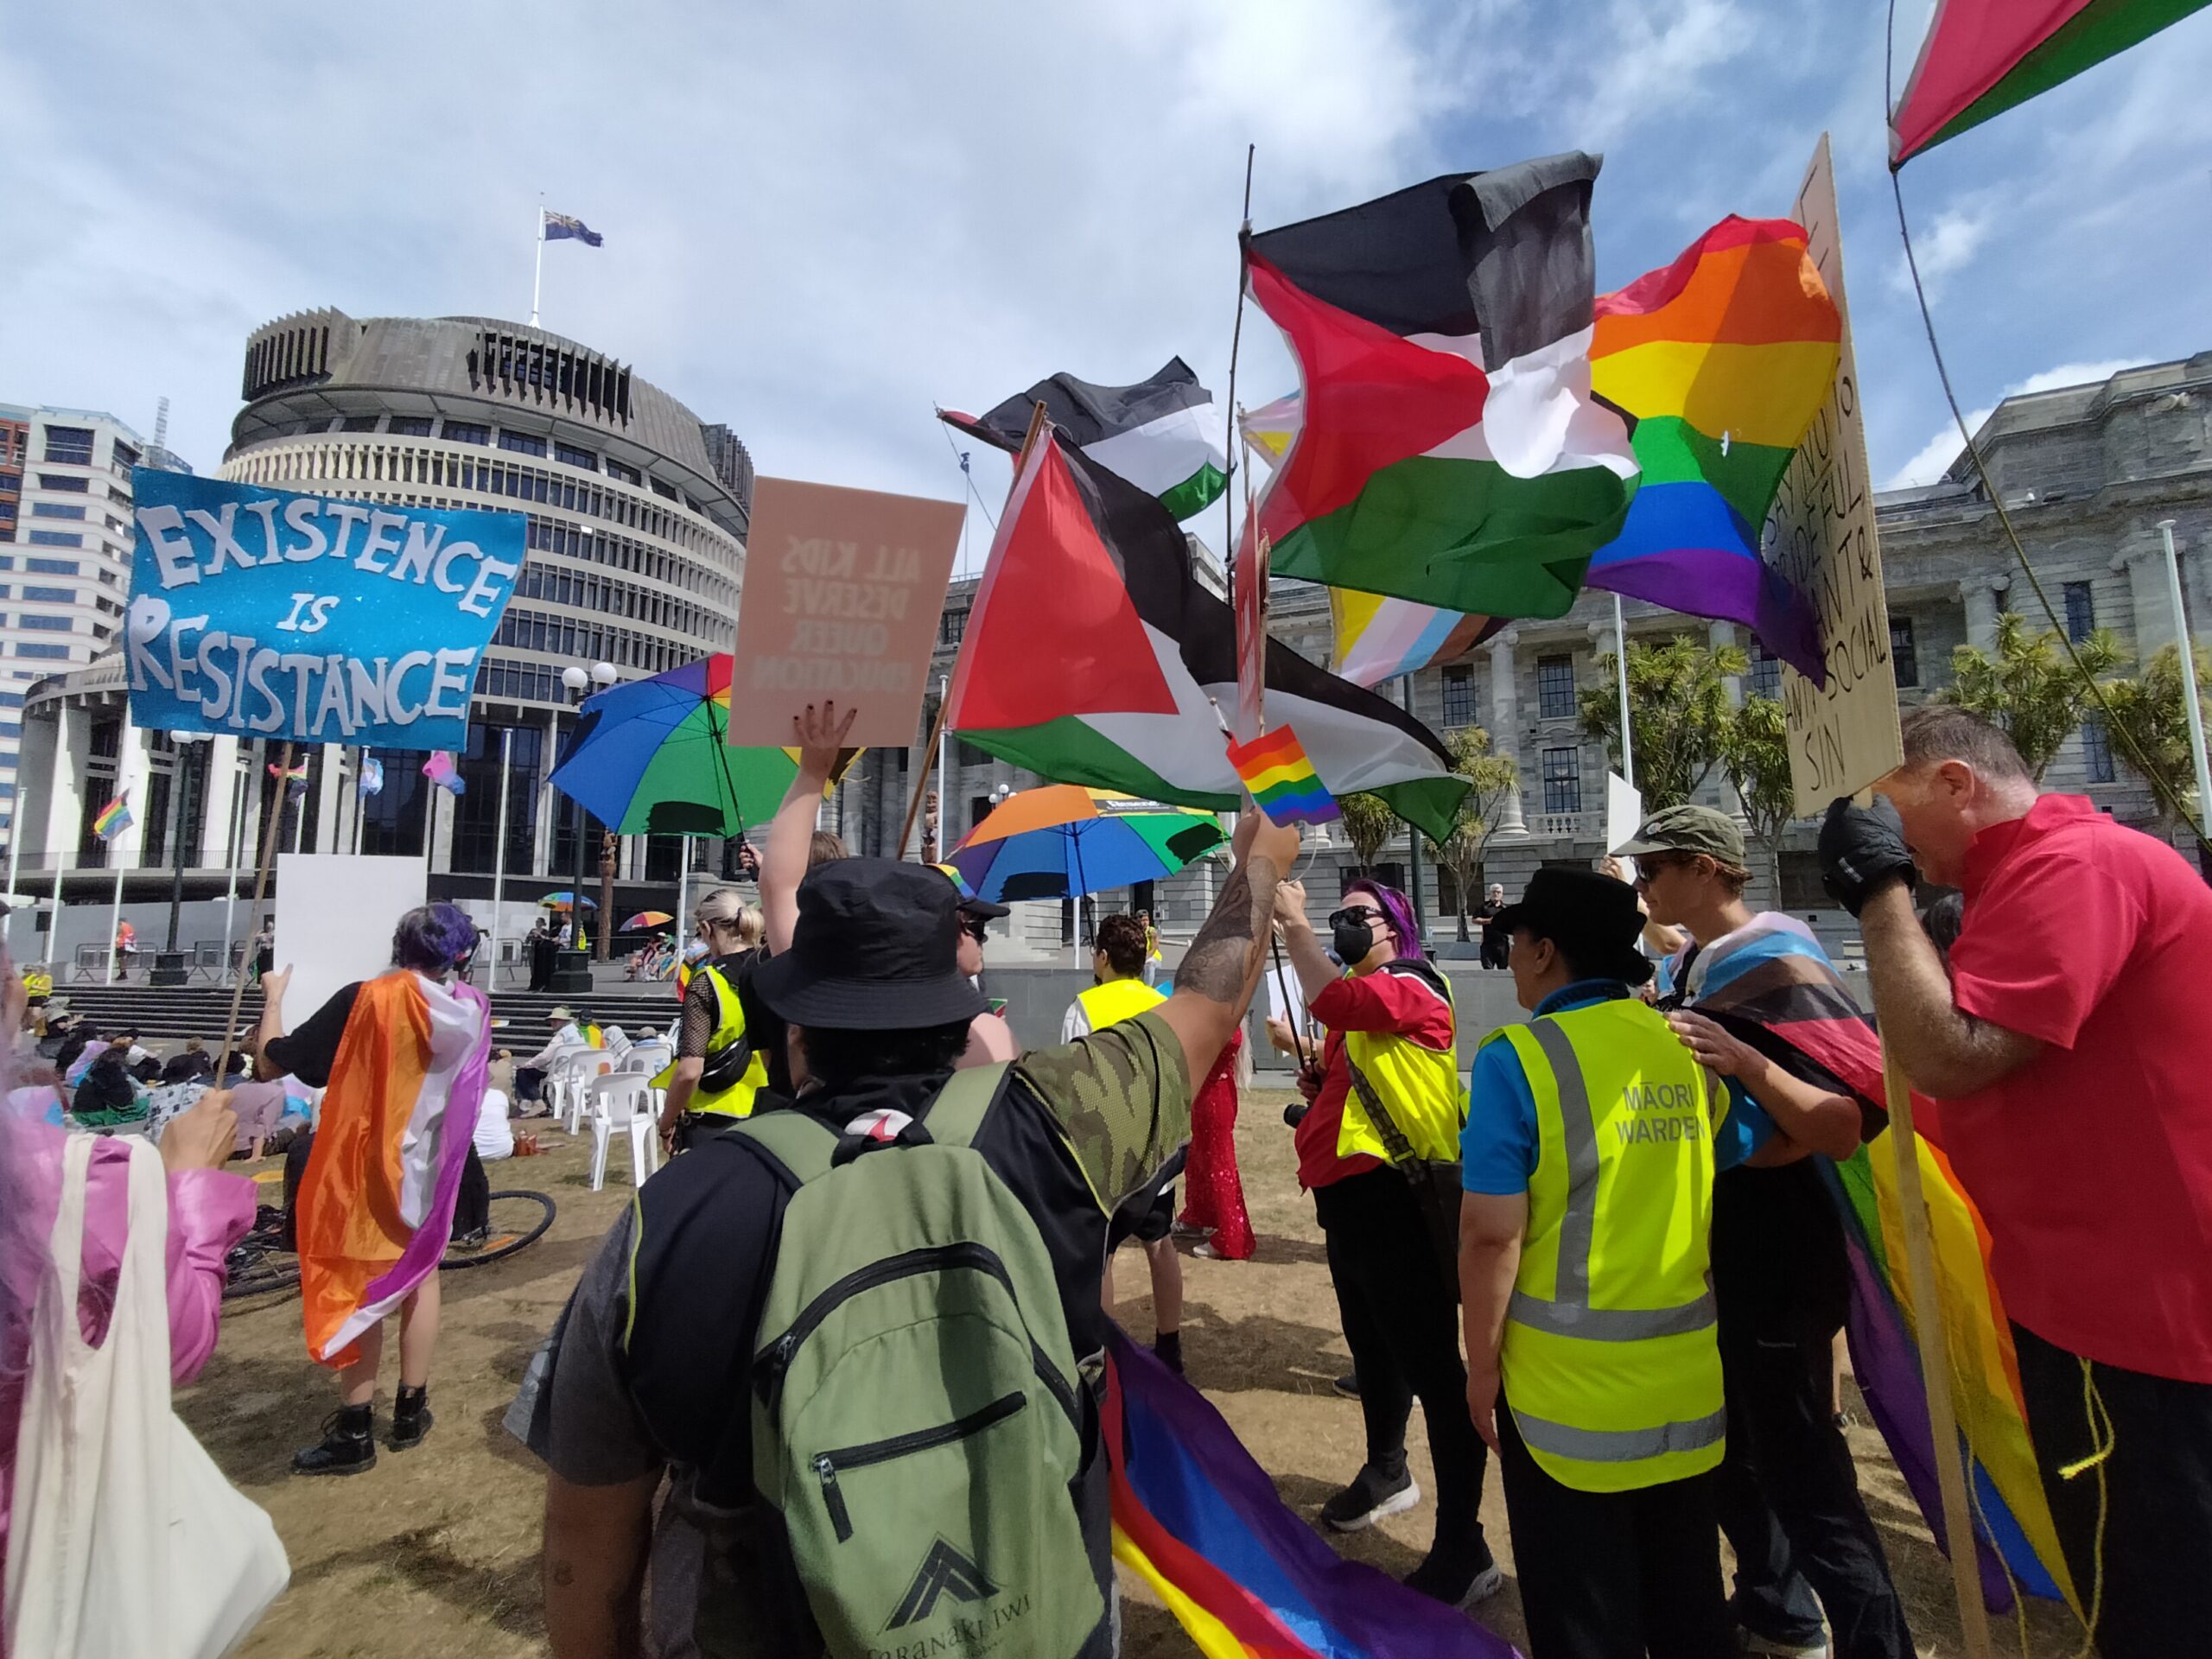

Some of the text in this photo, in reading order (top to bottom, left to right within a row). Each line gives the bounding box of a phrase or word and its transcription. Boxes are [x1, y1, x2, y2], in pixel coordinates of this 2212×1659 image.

[137, 497, 518, 620] EXISTENCE
[276, 592, 340, 632] IS
[128, 593, 478, 737] RESISTANCE
[1825, 602, 1887, 702] SOCIAL
[1804, 713, 1846, 791] SIN
[1623, 1081, 1694, 1111] MĀORI
[1615, 1115, 1706, 1145] WARDEN
[993, 1593, 1031, 1631] IWI
